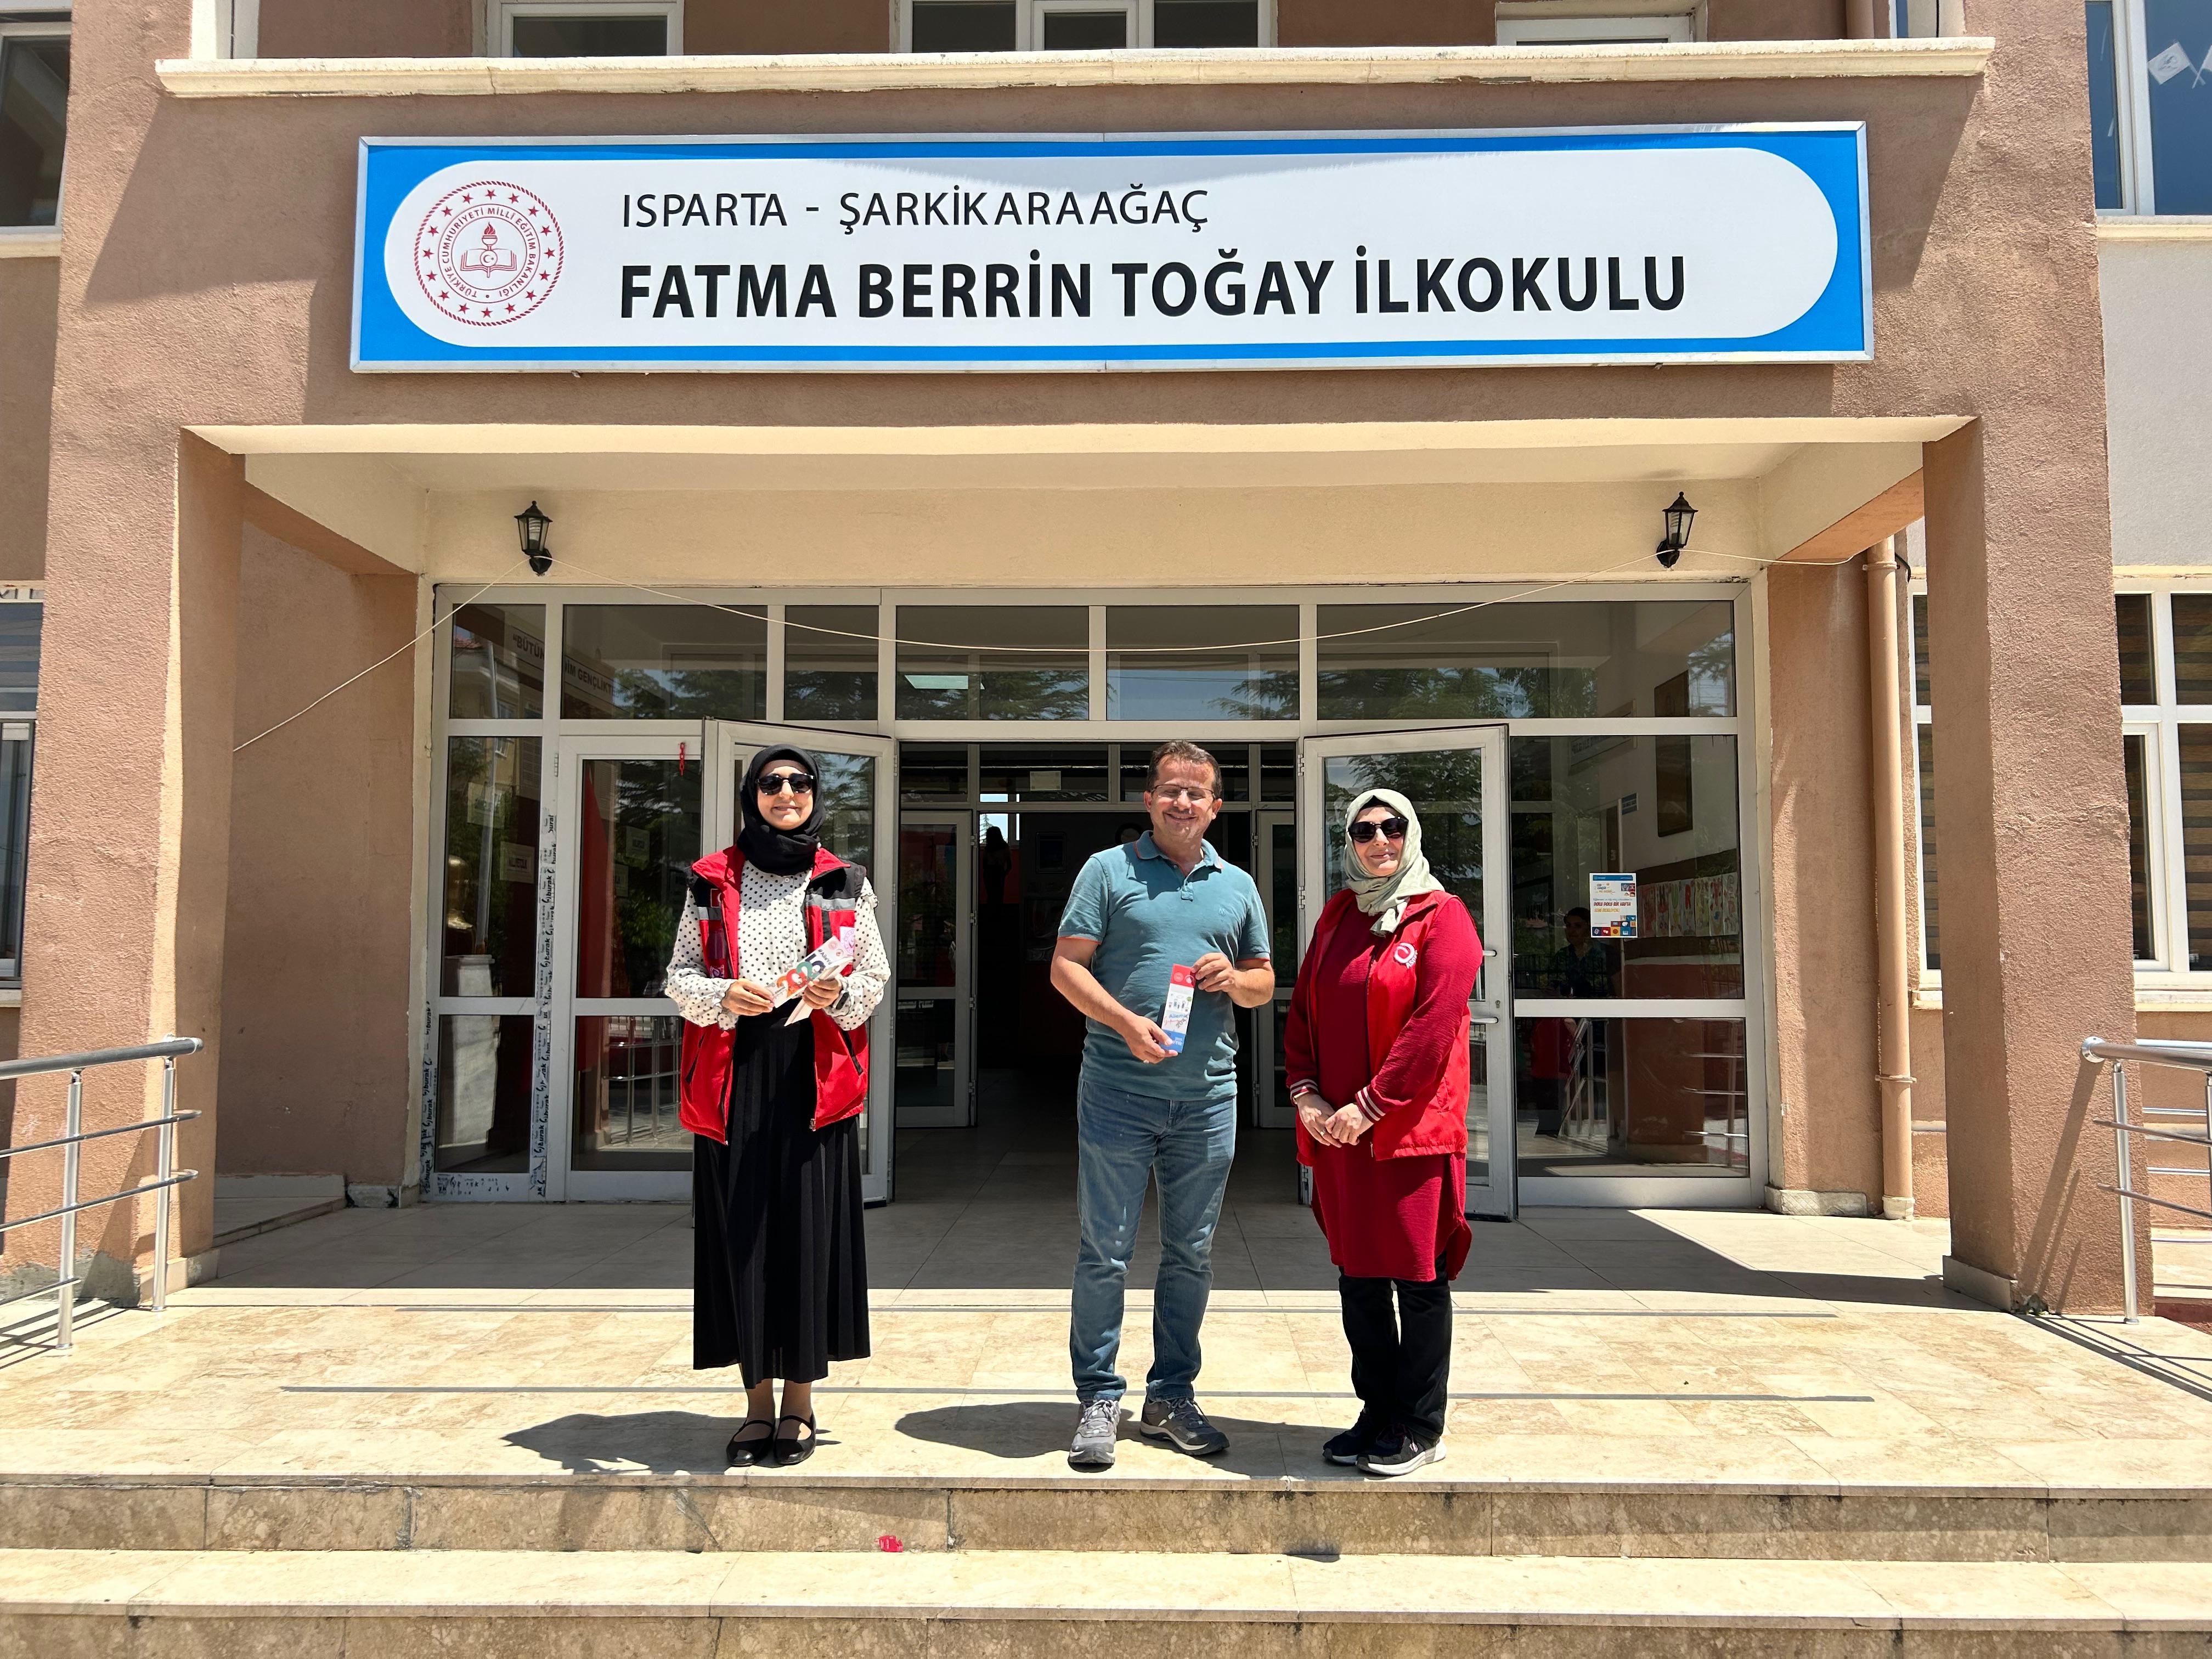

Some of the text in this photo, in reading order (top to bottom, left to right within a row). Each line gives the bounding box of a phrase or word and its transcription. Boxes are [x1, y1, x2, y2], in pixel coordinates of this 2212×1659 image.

[624, 193, 787, 228] ISPARTA
[839, 183, 1208, 235] ŞARKİKARAAĞAÇ
[442, 207, 536, 298] TÜRKİYE CUMHURİYETİ MİLLİ EĞİTİM BAKANLIĞI
[621, 245, 1684, 318] FATMA BERRİN TOĞAY İLKOKULU
